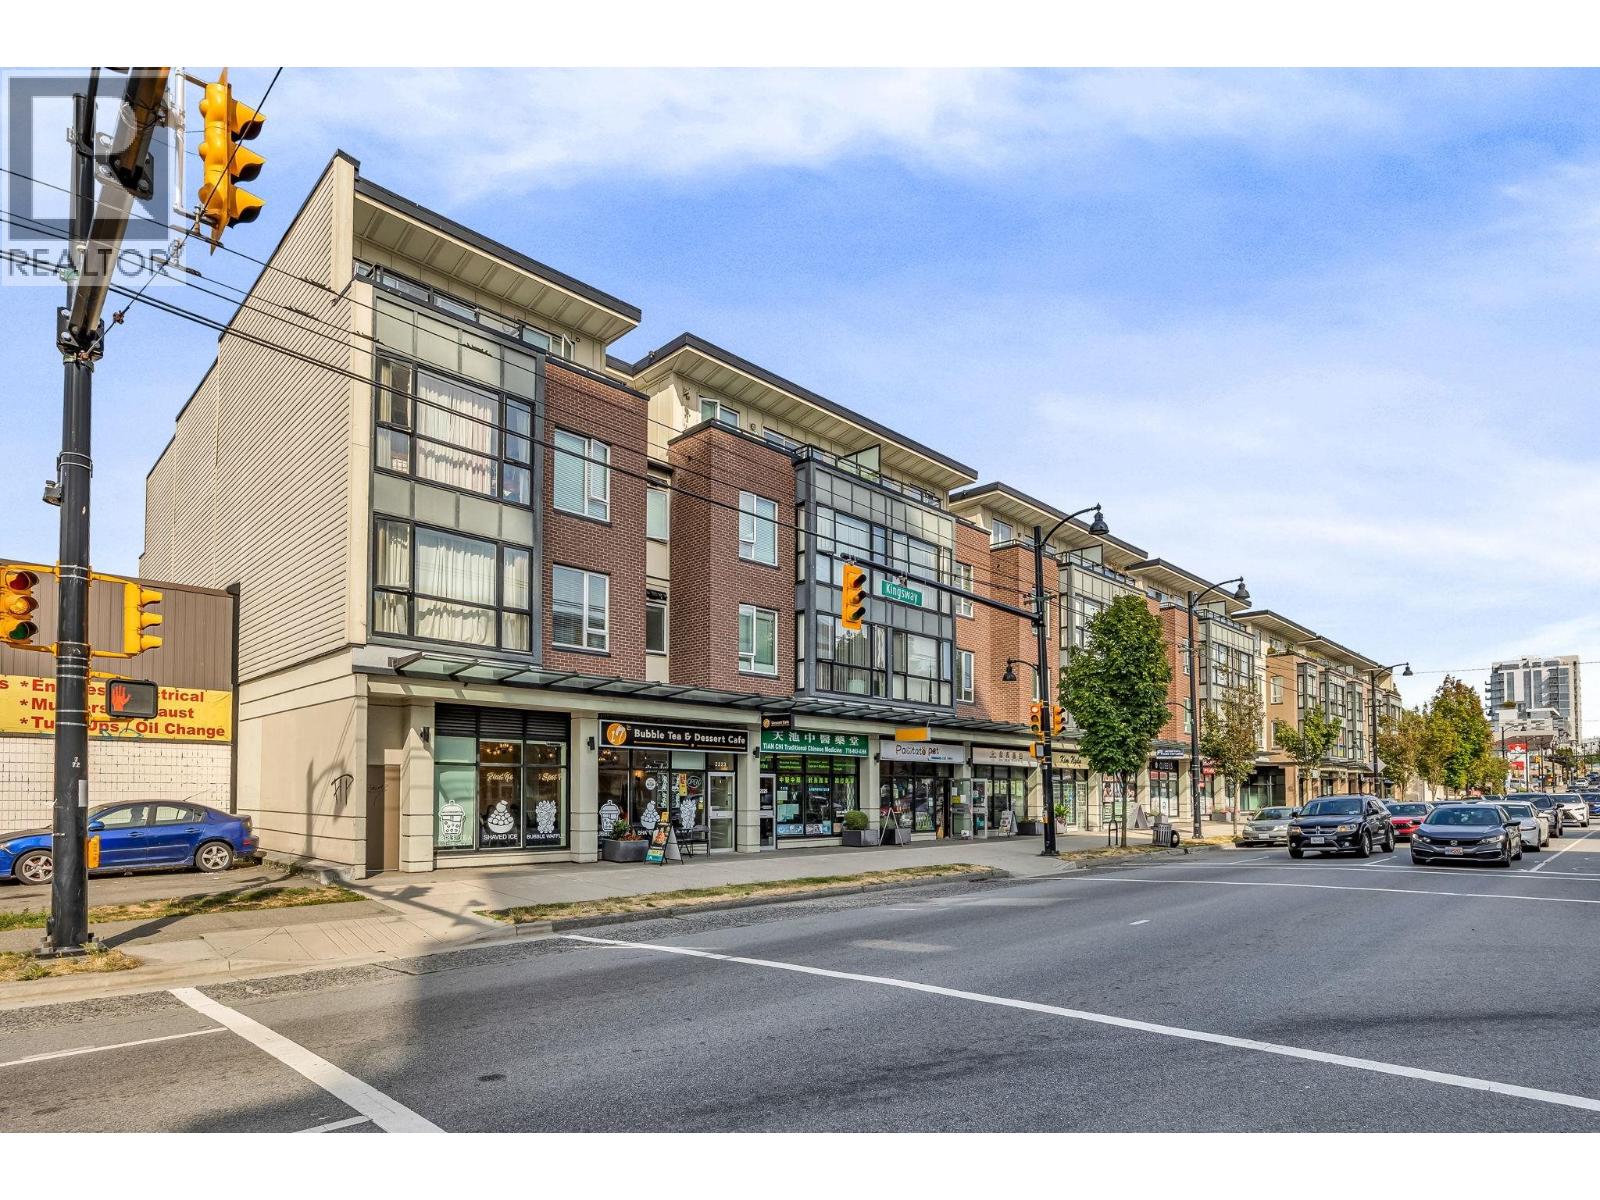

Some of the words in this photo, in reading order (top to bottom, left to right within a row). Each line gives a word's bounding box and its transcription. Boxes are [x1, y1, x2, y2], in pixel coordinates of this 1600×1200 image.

[886, 584, 918, 605] Kingsway
[136, 721, 158, 733] Oil
[165, 723, 225, 738] Change
[634, 729, 664, 739] Bubble
[668, 731, 682, 740] Tea
[694, 734, 726, 743] Dessert
[728, 736, 745, 744] Cafe
